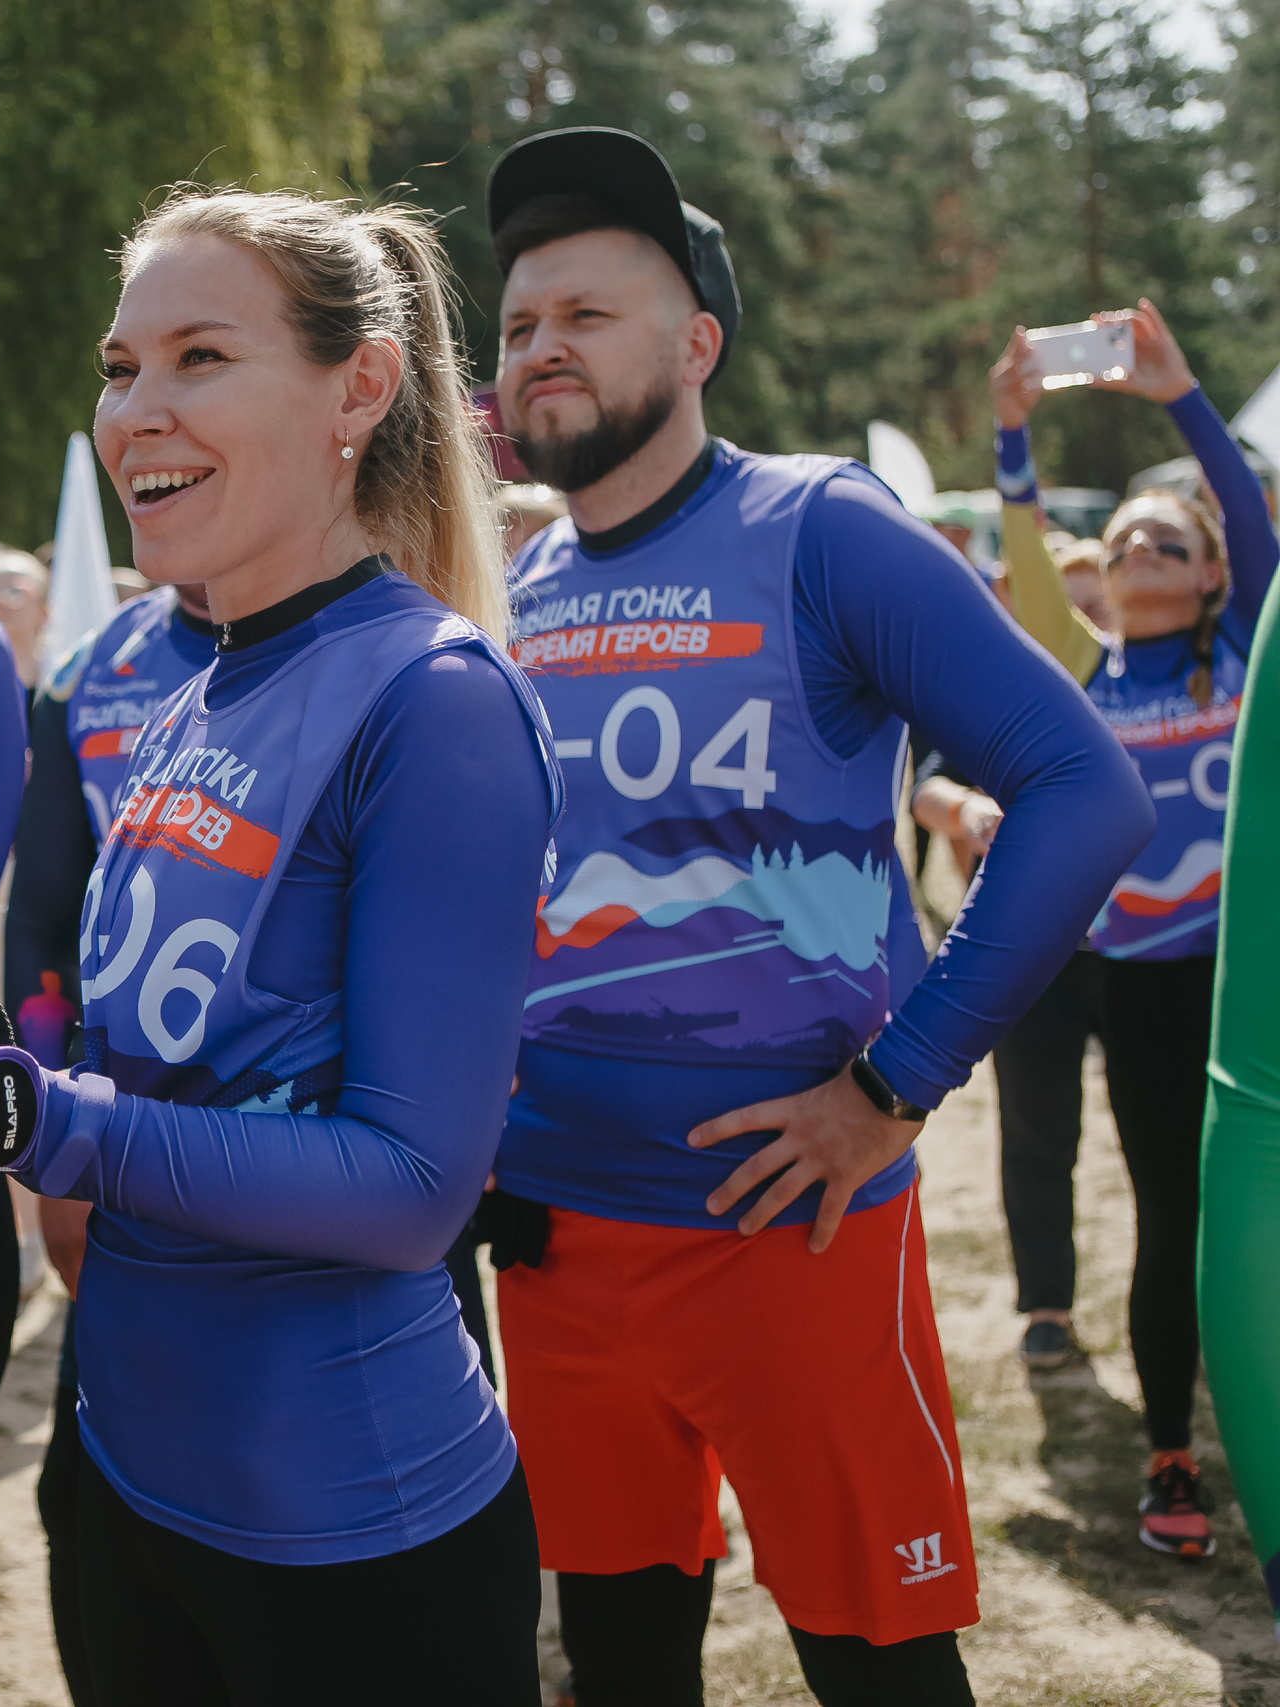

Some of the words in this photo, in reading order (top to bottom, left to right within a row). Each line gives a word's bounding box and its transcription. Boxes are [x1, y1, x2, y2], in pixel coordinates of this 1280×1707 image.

[605, 585, 713, 623] ГОНКА
[598, 622, 711, 656] ГЕРОЕВ
[3, 1075, 18, 1150] SILAPRO
